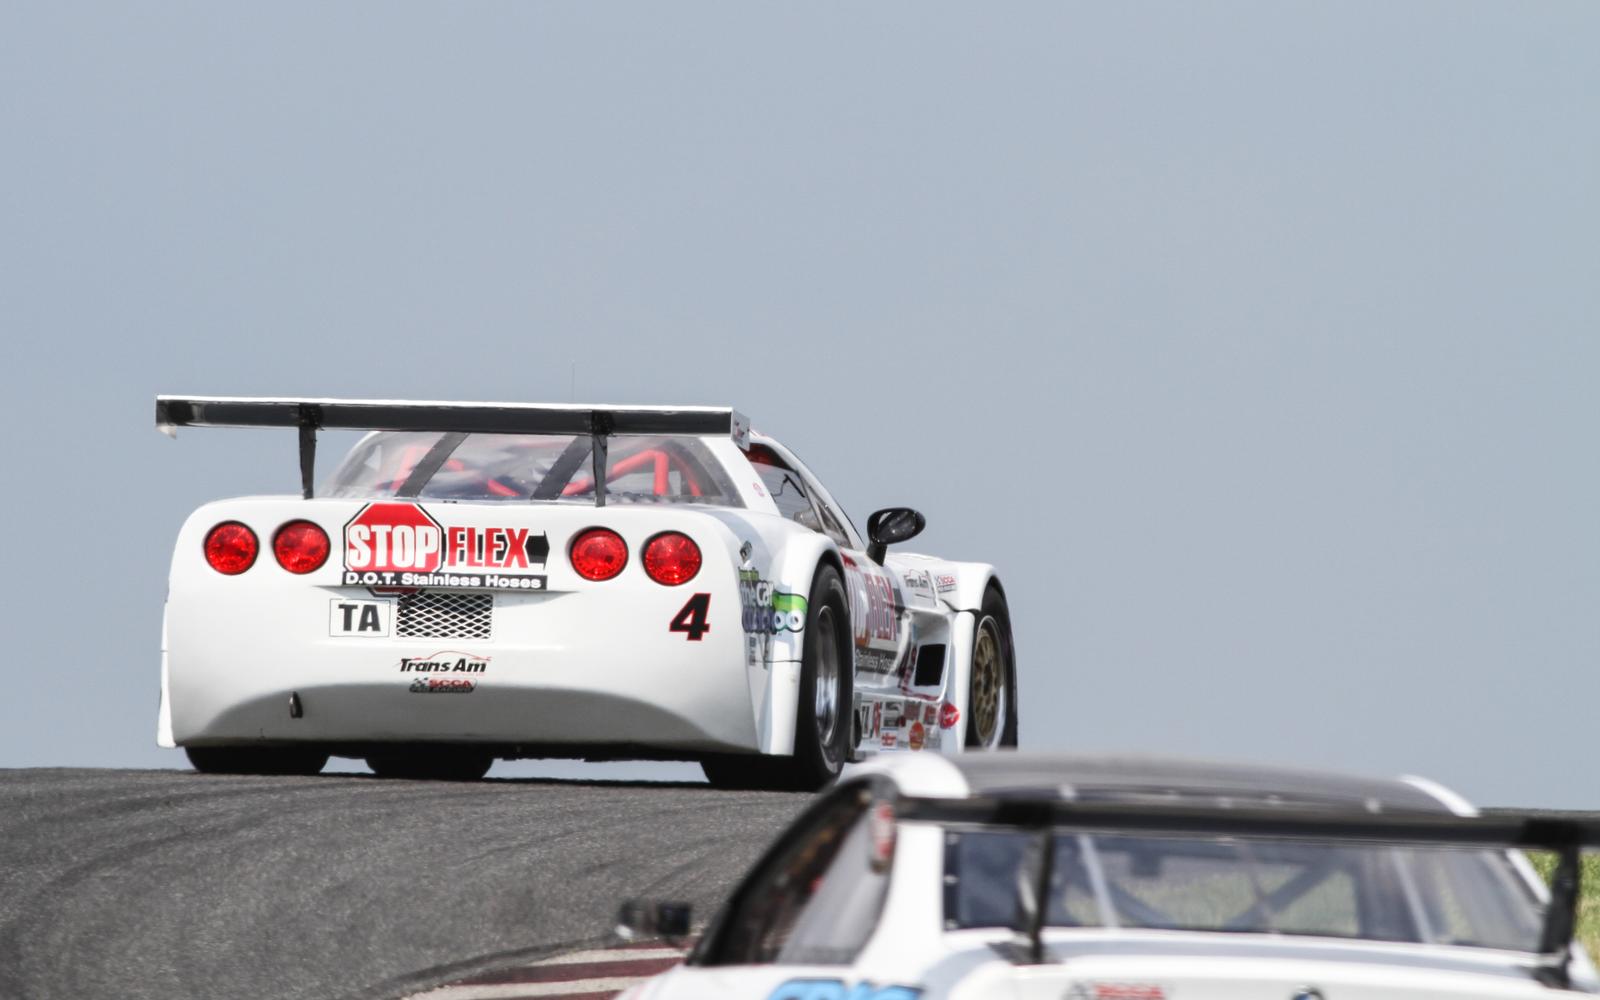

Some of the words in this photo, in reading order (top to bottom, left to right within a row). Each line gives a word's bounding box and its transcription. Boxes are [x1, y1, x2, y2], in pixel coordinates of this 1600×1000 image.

[349, 524, 438, 568] STOP
[447, 526, 529, 568] FLEX
[345, 572, 397, 585] D.O.T.
[401, 573, 481, 587] Stainless
[485, 575, 542, 589] Hoses
[338, 604, 381, 632] TA
[669, 593, 711, 641] 4
[400, 658, 451, 672] Trans
[452, 658, 487, 672] Am
